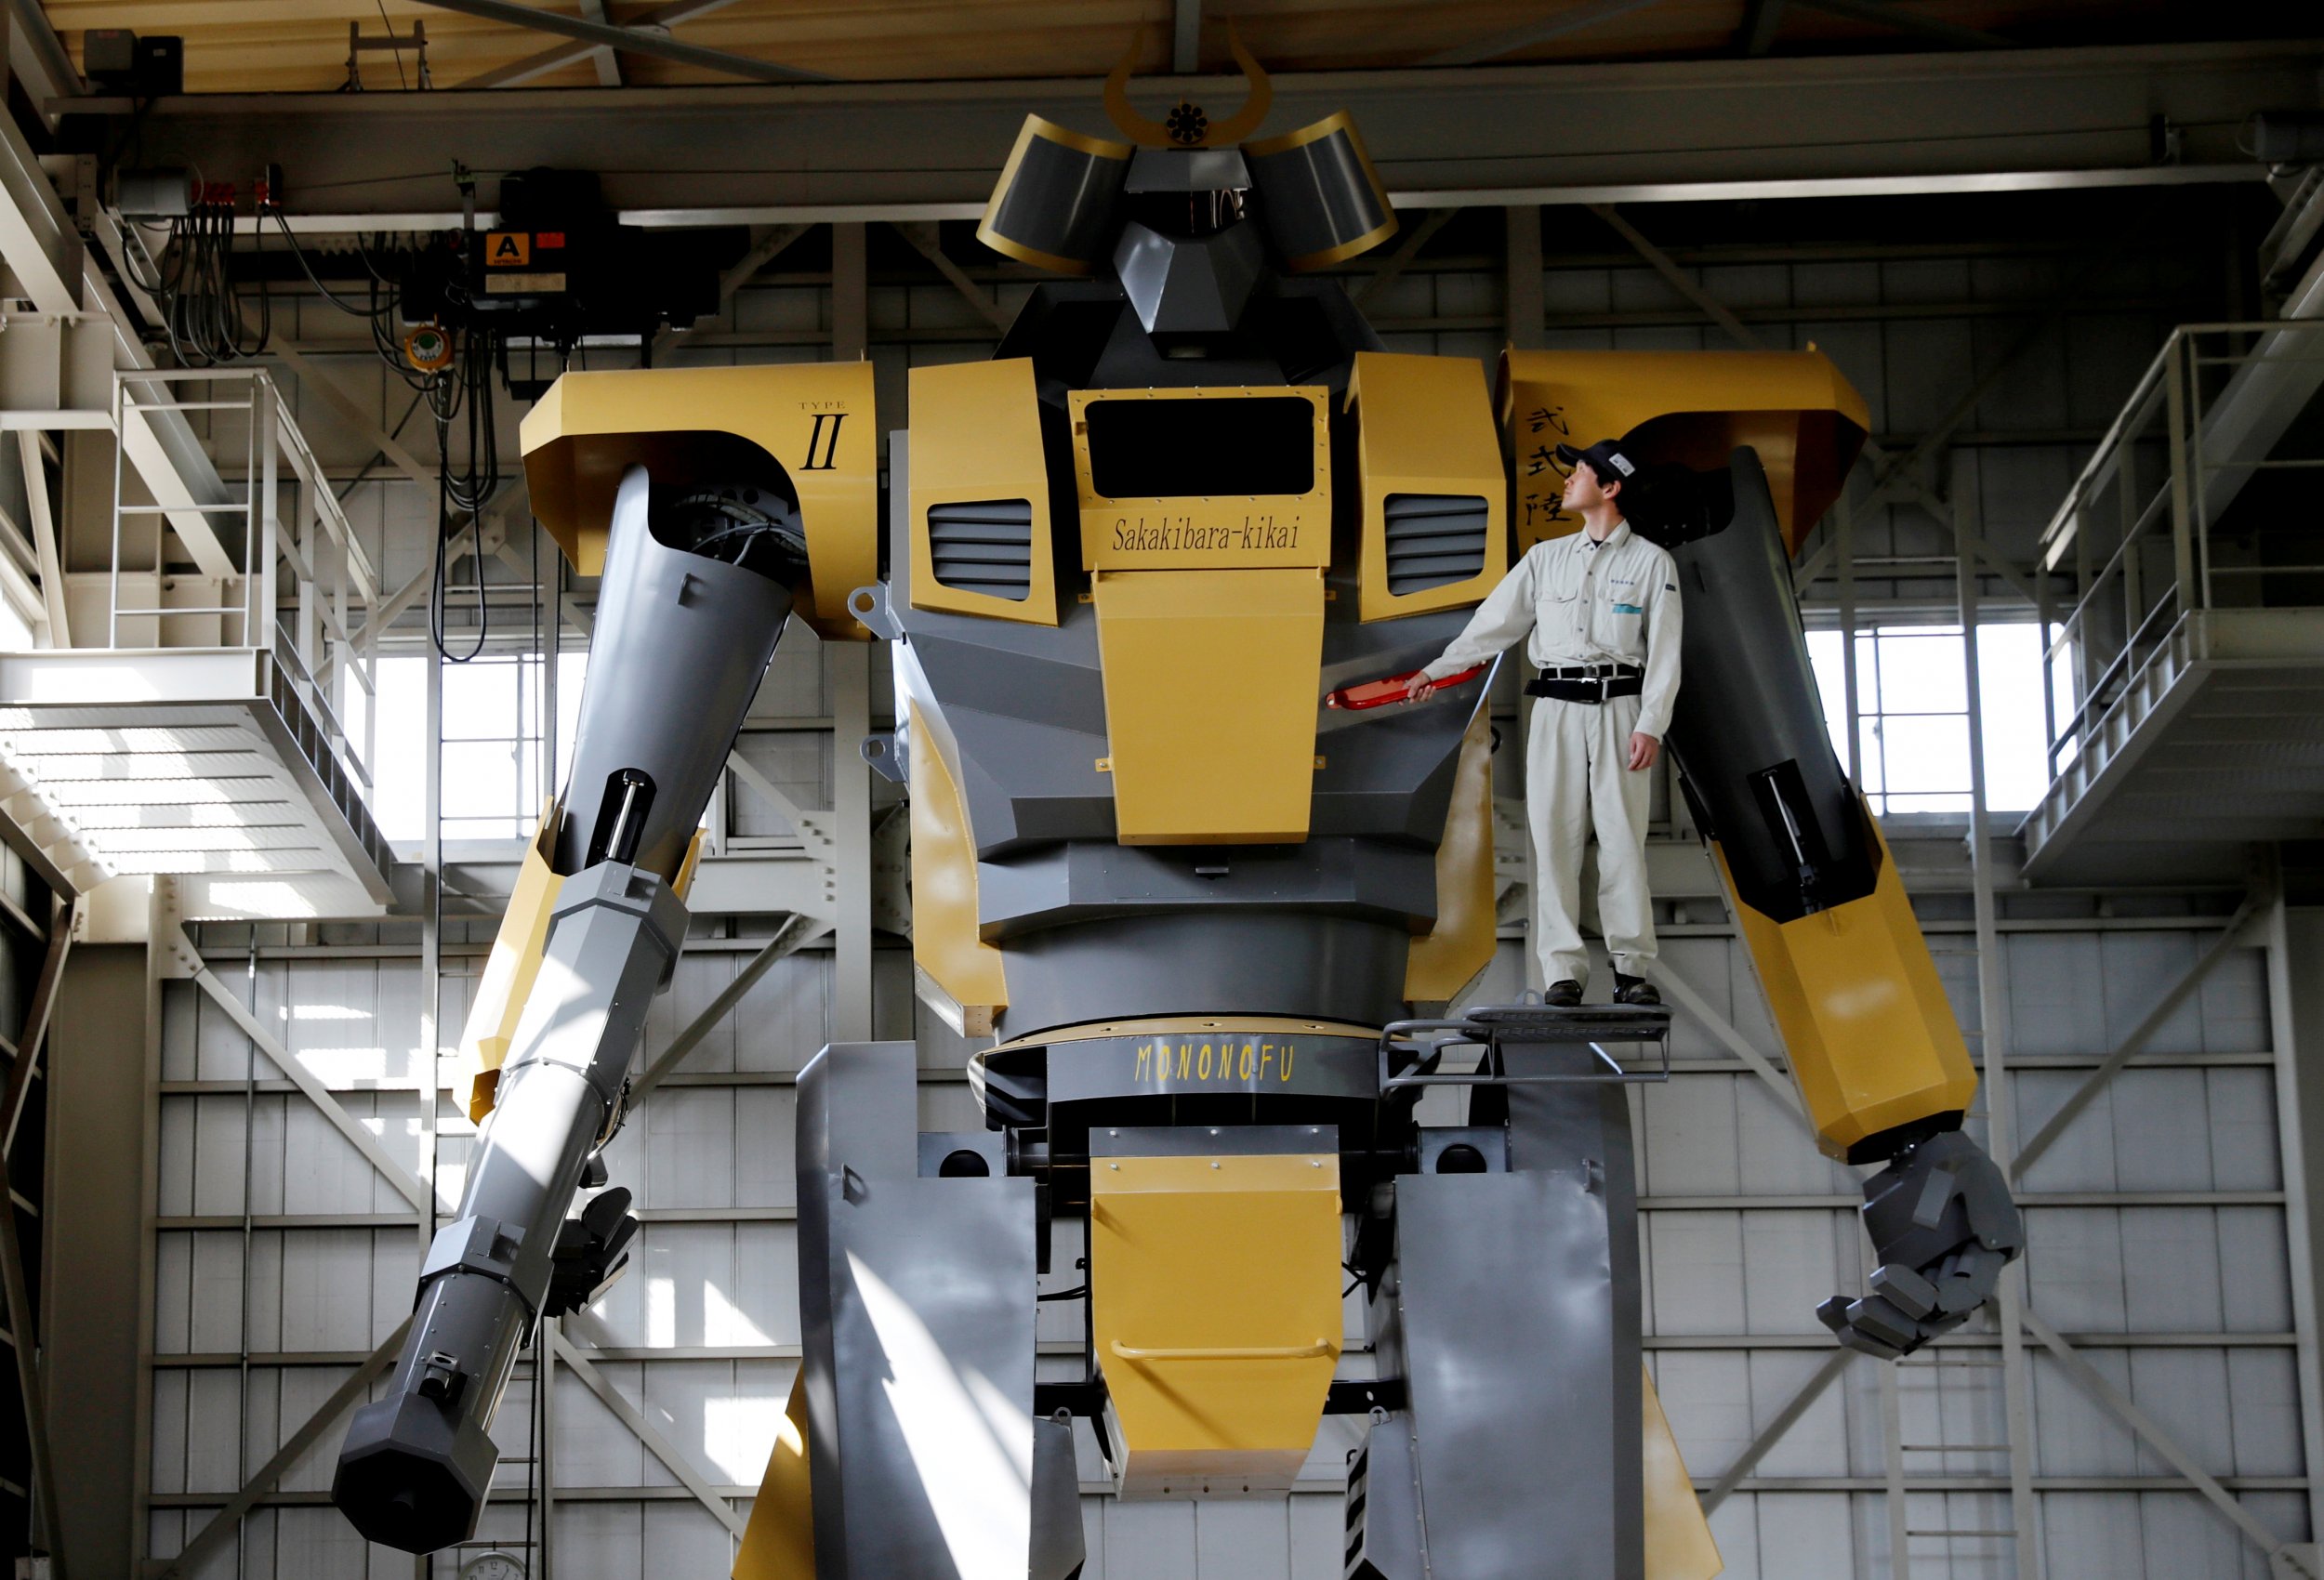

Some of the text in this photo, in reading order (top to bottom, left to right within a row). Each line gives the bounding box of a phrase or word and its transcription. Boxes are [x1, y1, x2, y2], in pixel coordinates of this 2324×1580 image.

[496, 236, 520, 257] A
[799, 402, 846, 410] TYPE
[799, 414, 850, 470] II
[1525, 406, 1571, 545] 弐式陸
[1113, 516, 1301, 551] Sakakibara-kikai
[1135, 1043, 1294, 1082] MONONOFU
